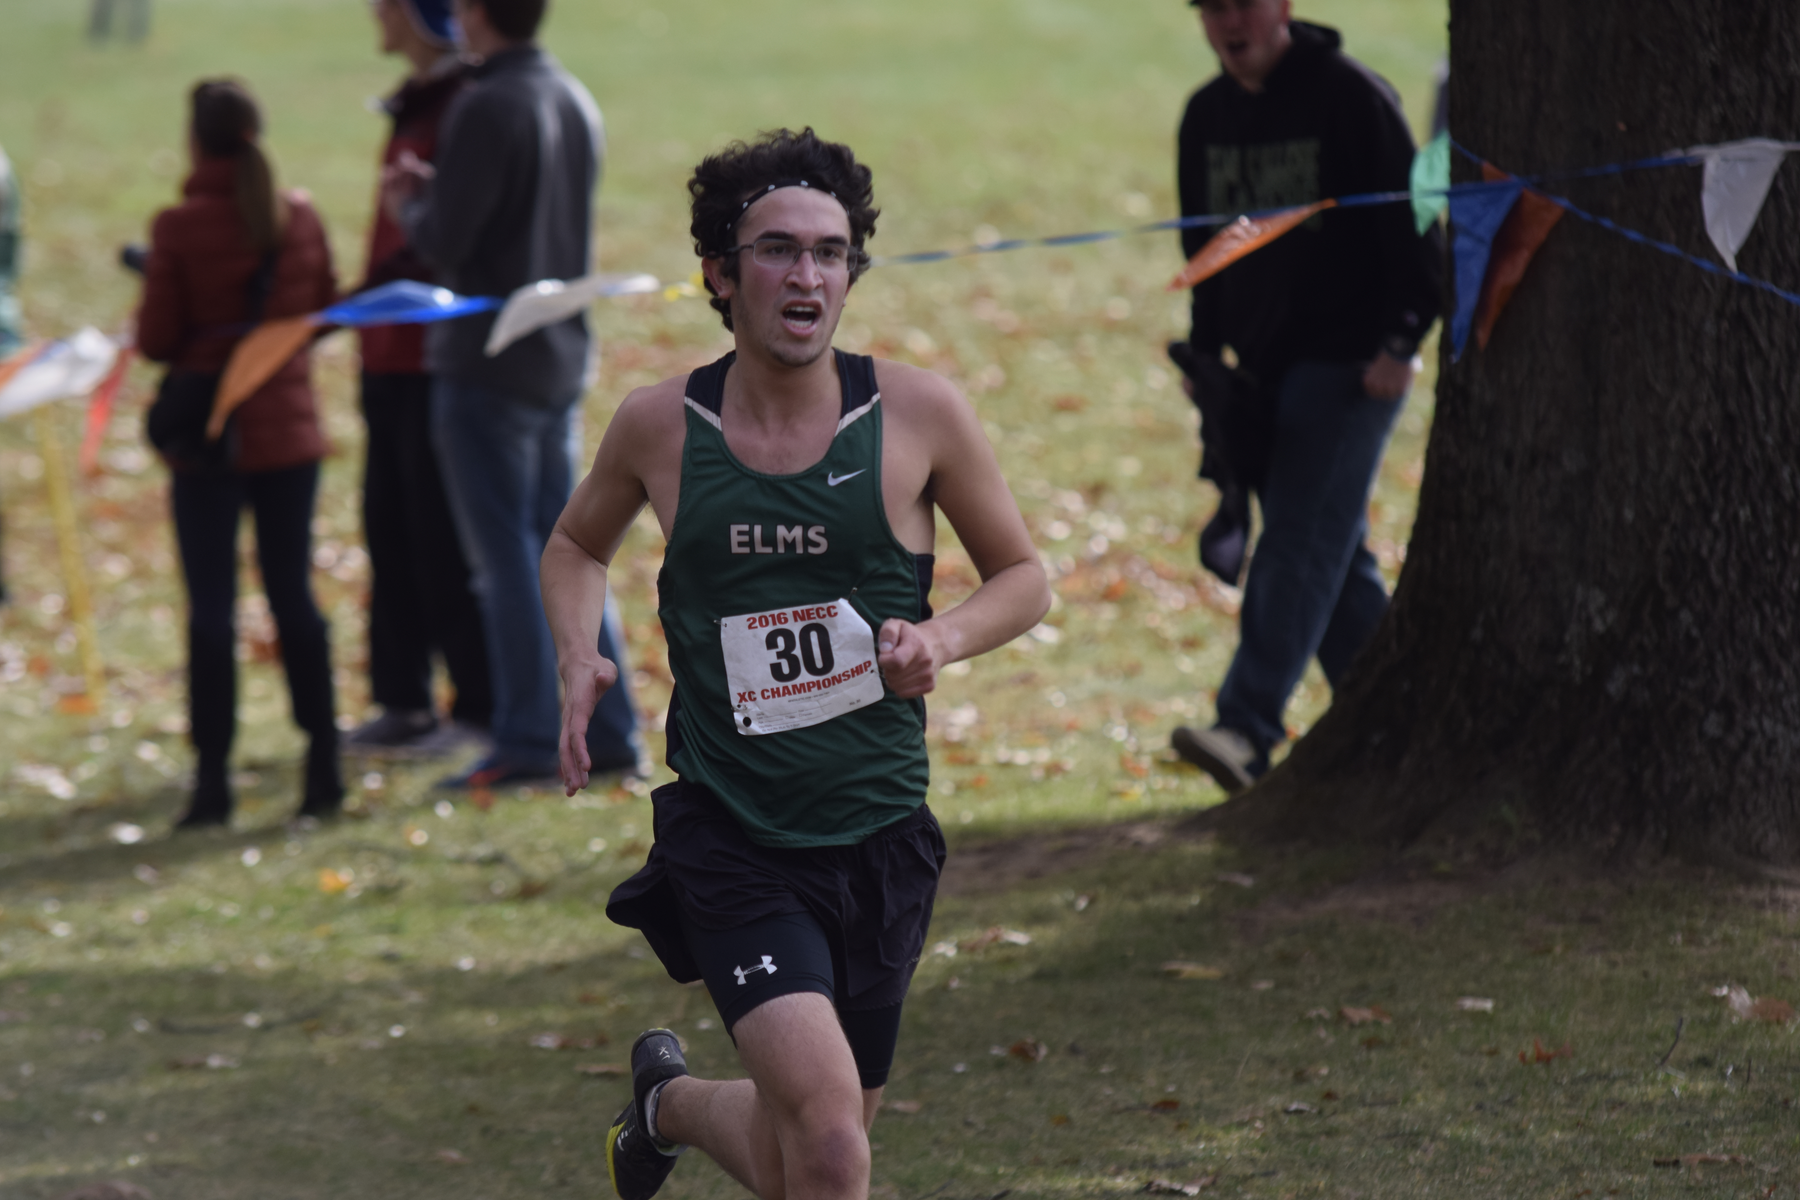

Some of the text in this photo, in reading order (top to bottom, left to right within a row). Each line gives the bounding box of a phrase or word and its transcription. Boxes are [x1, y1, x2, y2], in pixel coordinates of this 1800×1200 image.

[730, 524, 828, 555] ELMS
[746, 605, 839, 630] 2016 NECC
[765, 622, 835, 683] 30
[736, 690, 757, 703] XC
[760, 660, 872, 701] CHAMPIONSHIP
